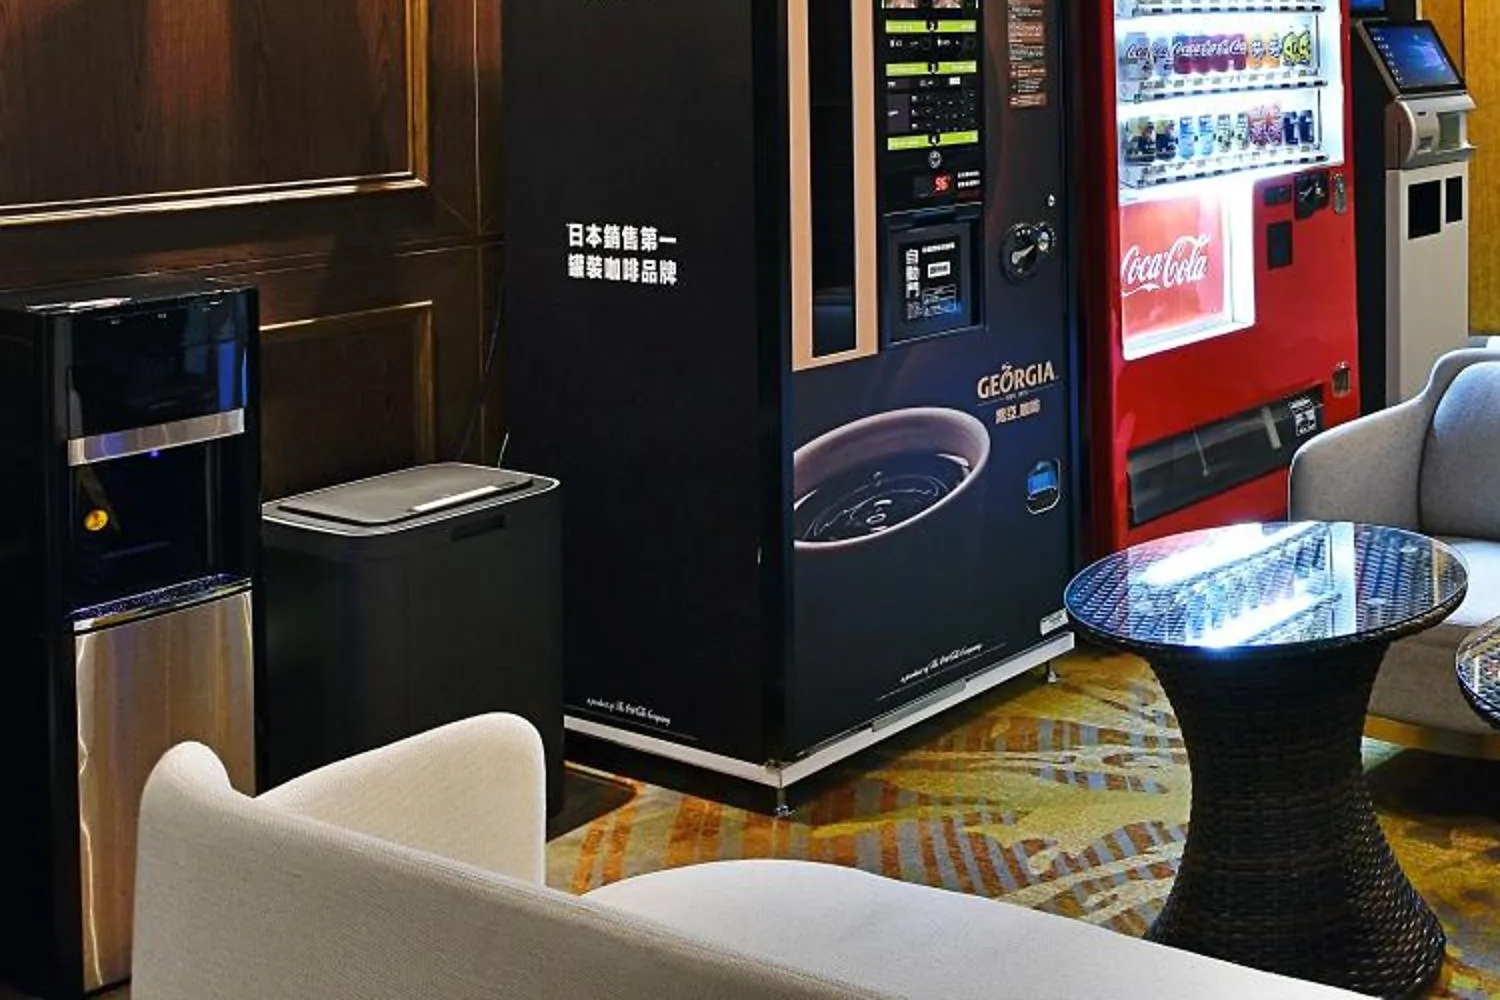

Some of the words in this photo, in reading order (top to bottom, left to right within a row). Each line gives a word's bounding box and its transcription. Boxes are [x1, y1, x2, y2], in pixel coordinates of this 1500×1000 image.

[565, 222, 677, 251] 日本銷售第一
[977, 360, 1055, 399] GEORGIA
